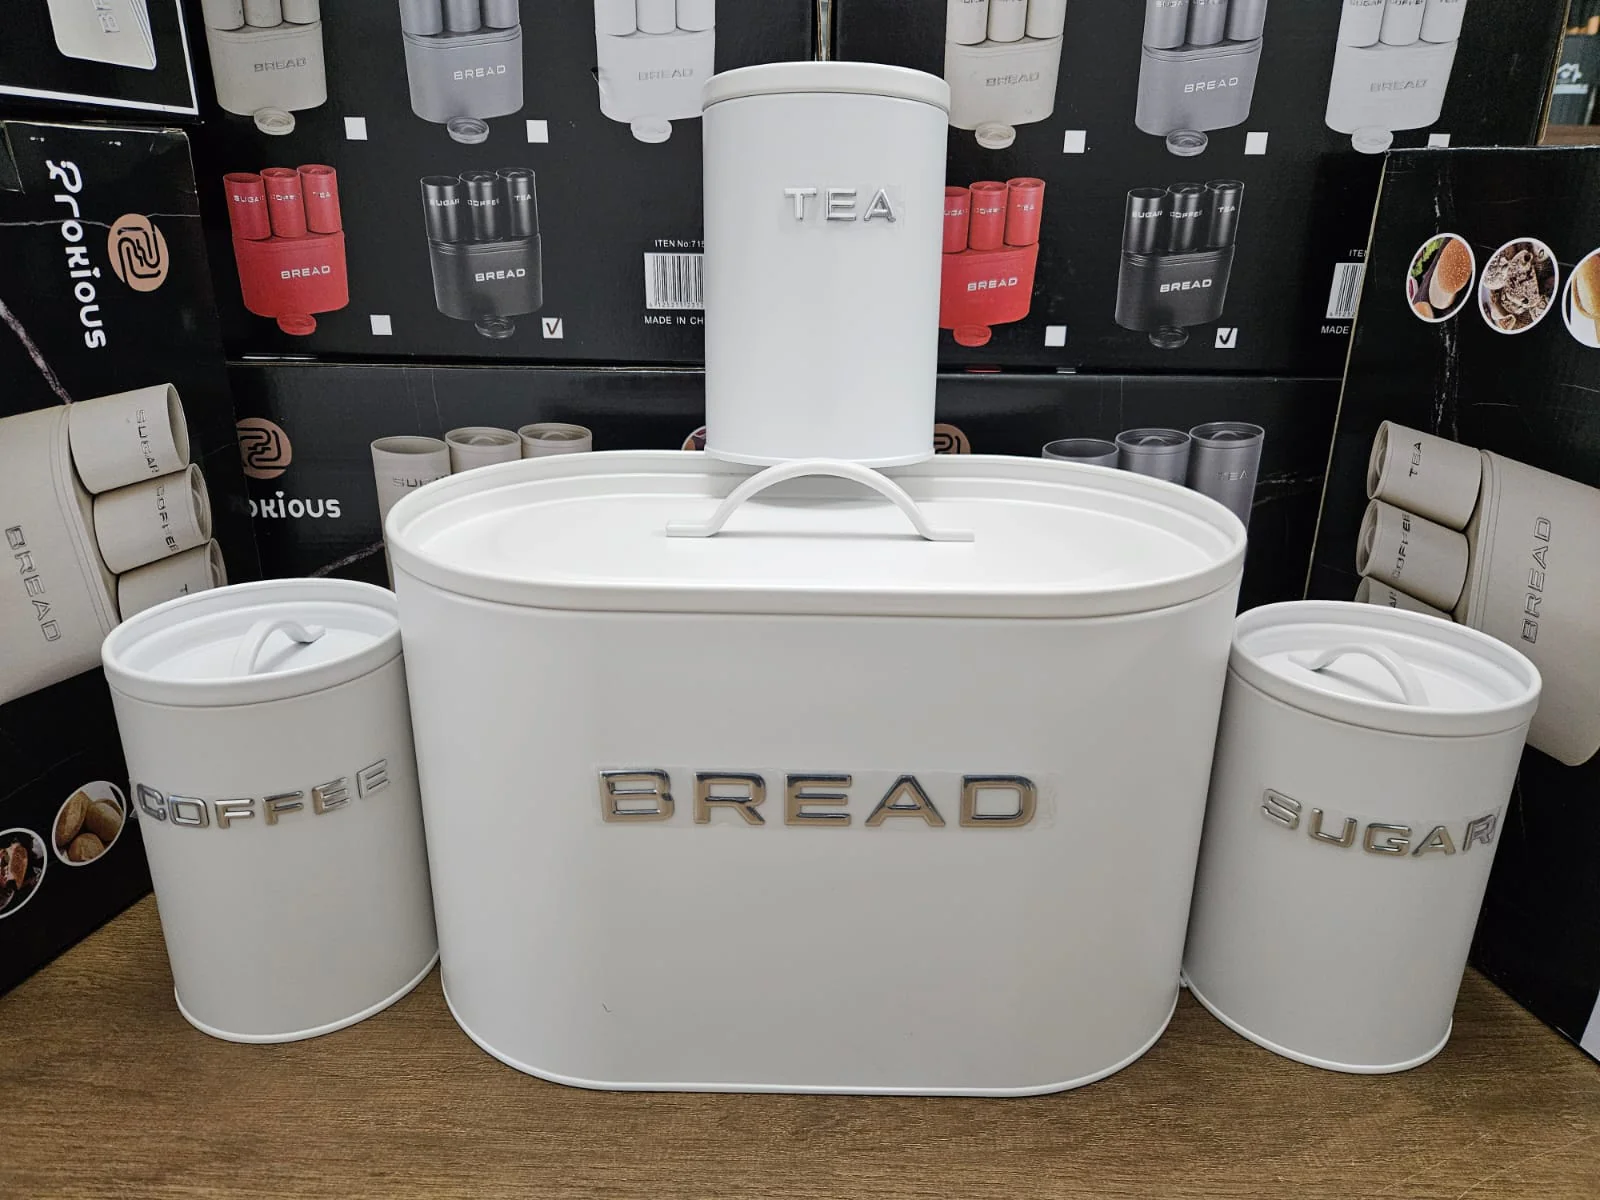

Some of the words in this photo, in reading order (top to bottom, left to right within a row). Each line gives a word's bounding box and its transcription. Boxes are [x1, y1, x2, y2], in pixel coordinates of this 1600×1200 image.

[253, 57, 307, 73] BREAD
[453, 65, 506, 80] BREAD
[638, 67, 694, 82] BREAD
[985, 72, 1040, 88] BREAD
[1184, 77, 1239, 93] BREAD
[783, 187, 897, 223] TEA
[280, 265, 331, 280] BREAD
[474, 268, 526, 282] BREAD
[967, 276, 1019, 292] BREAD
[1159, 279, 1213, 293] BREAD
[643, 315, 673, 325] MADE
[676, 316, 686, 325] IN
[1320, 325, 1351, 335] MADE
[1408, 441, 1423, 479] TEA
[4, 524, 62, 643] BREAD
[1521, 516, 1552, 644] BREAD
[136, 758, 392, 830] COFFEE
[599, 767, 1039, 829] BREAD
[1260, 787, 1498, 858] SUGAR
